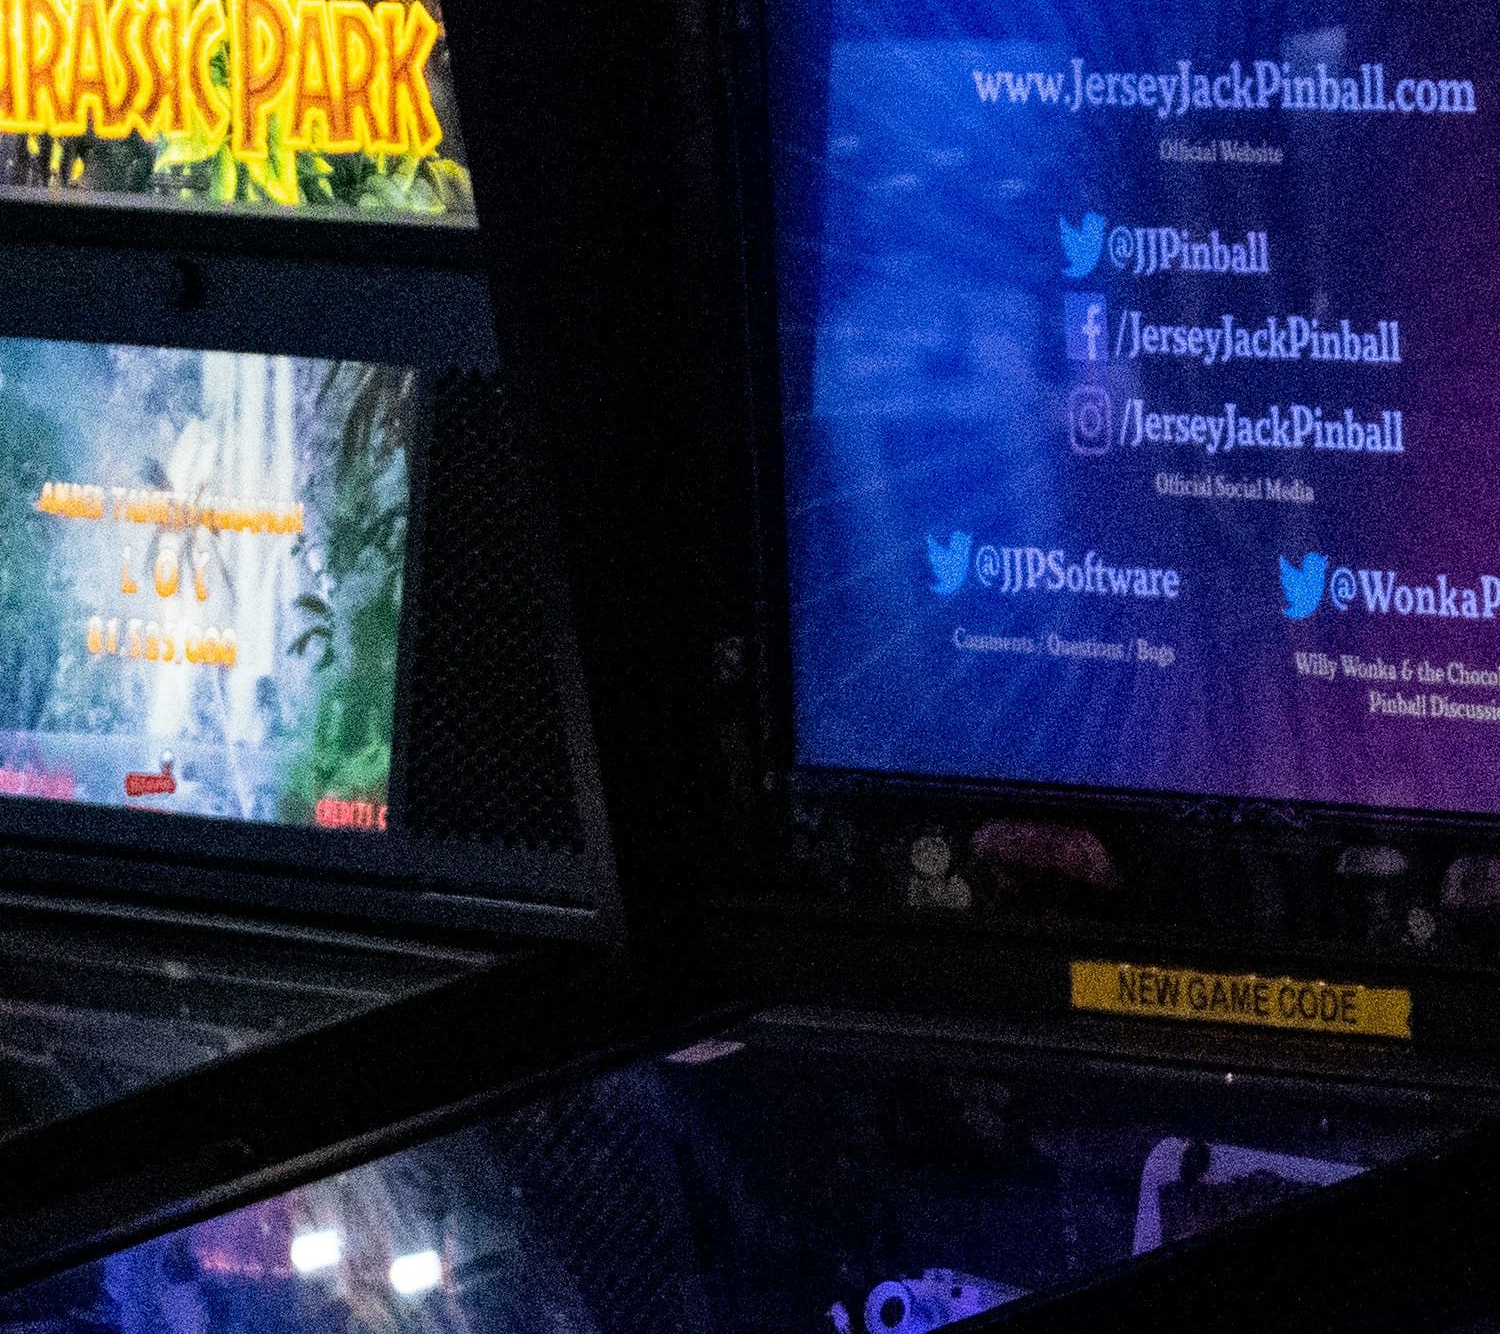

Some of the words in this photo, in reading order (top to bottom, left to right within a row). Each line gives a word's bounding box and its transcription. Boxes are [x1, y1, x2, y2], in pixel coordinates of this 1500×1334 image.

[972, 57, 1478, 121] www.JerseyJackPinball.com
[1158, 138, 1217, 166] Official
[1219, 140, 1285, 167] Website
[1106, 223, 1271, 276] @JJPinball
[1114, 310, 1402, 366] /JerseyJackPinball
[1117, 397, 1406, 455] /JerseyJackPinball
[1154, 470, 1213, 501] Official
[1214, 474, 1264, 501] Social
[1266, 478, 1316, 505] Media
[972, 541, 1181, 601] @JJPSoftware
[953, 626, 1036, 657] Comments
[1047, 631, 1125, 664] Questions
[1136, 638, 1176, 669] Bugs
[1294, 650, 1338, 683] Willy
[1340, 655, 1398, 683] Wonka
[1416, 660, 1443, 685] the
[1368, 692, 1428, 719] Pinball
[1116, 966, 1183, 1008] NEW
[1190, 971, 1271, 1019] GAME
[1278, 978, 1360, 1026] CODE
